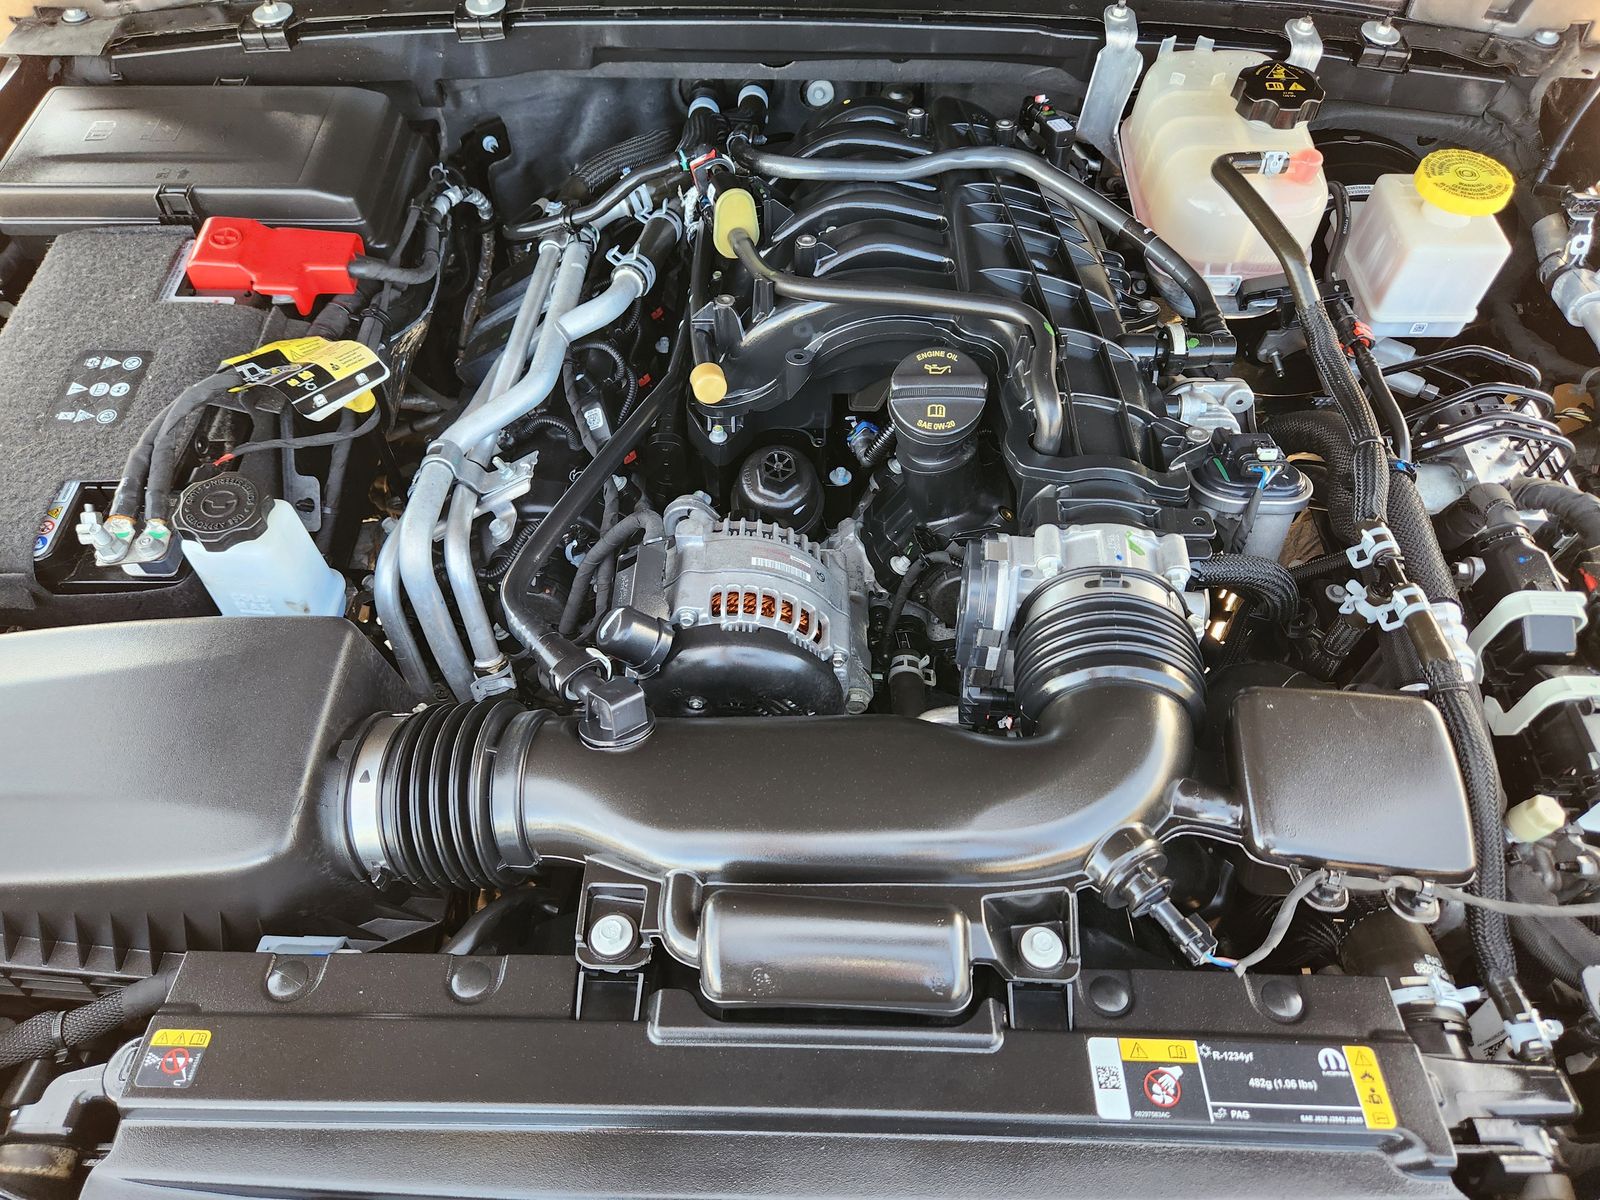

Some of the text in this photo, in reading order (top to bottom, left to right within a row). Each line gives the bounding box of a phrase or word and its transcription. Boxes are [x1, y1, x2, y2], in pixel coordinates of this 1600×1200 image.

[916, 350, 958, 362] ENGINE OIL
[916, 419, 956, 430] SAE 0W-20
[185, 514, 225, 530] APPROVED
[1212, 1050, 1254, 1063] R-1234yf
[1248, 1077, 1318, 1092] 482g (1.06 lbs)
[1230, 1109, 1251, 1120] PAG
